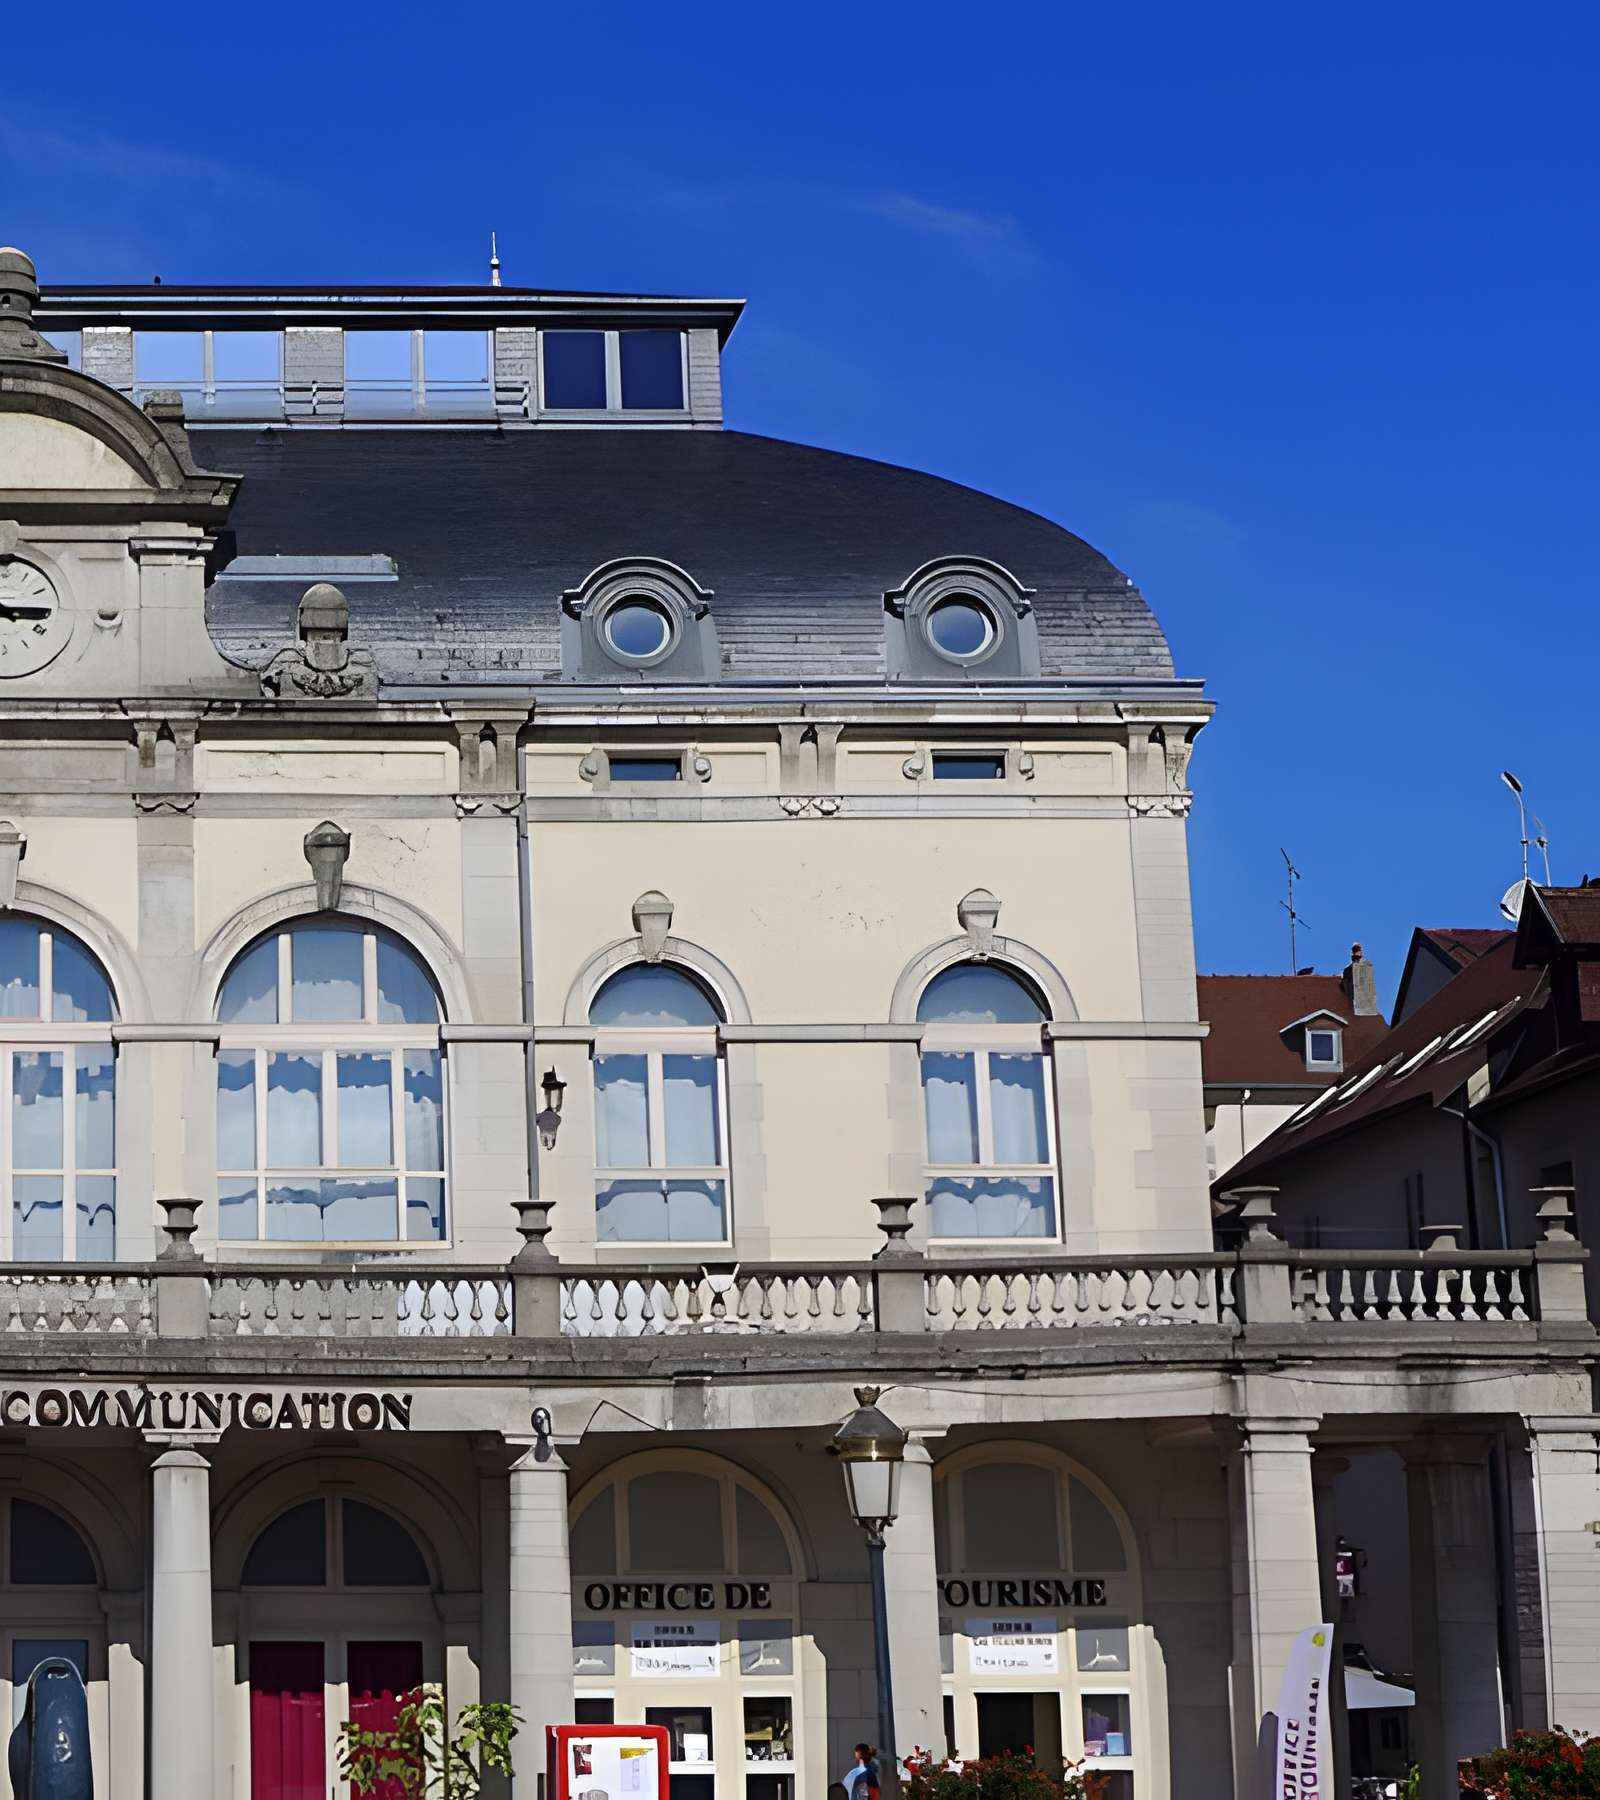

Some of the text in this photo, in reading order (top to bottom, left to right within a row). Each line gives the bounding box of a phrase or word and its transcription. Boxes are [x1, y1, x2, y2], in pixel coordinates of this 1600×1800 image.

[1, 1387, 413, 1431] COMMUNICATION
[584, 1583, 715, 1610] OFFICE
[724, 1583, 772, 1610] DE
